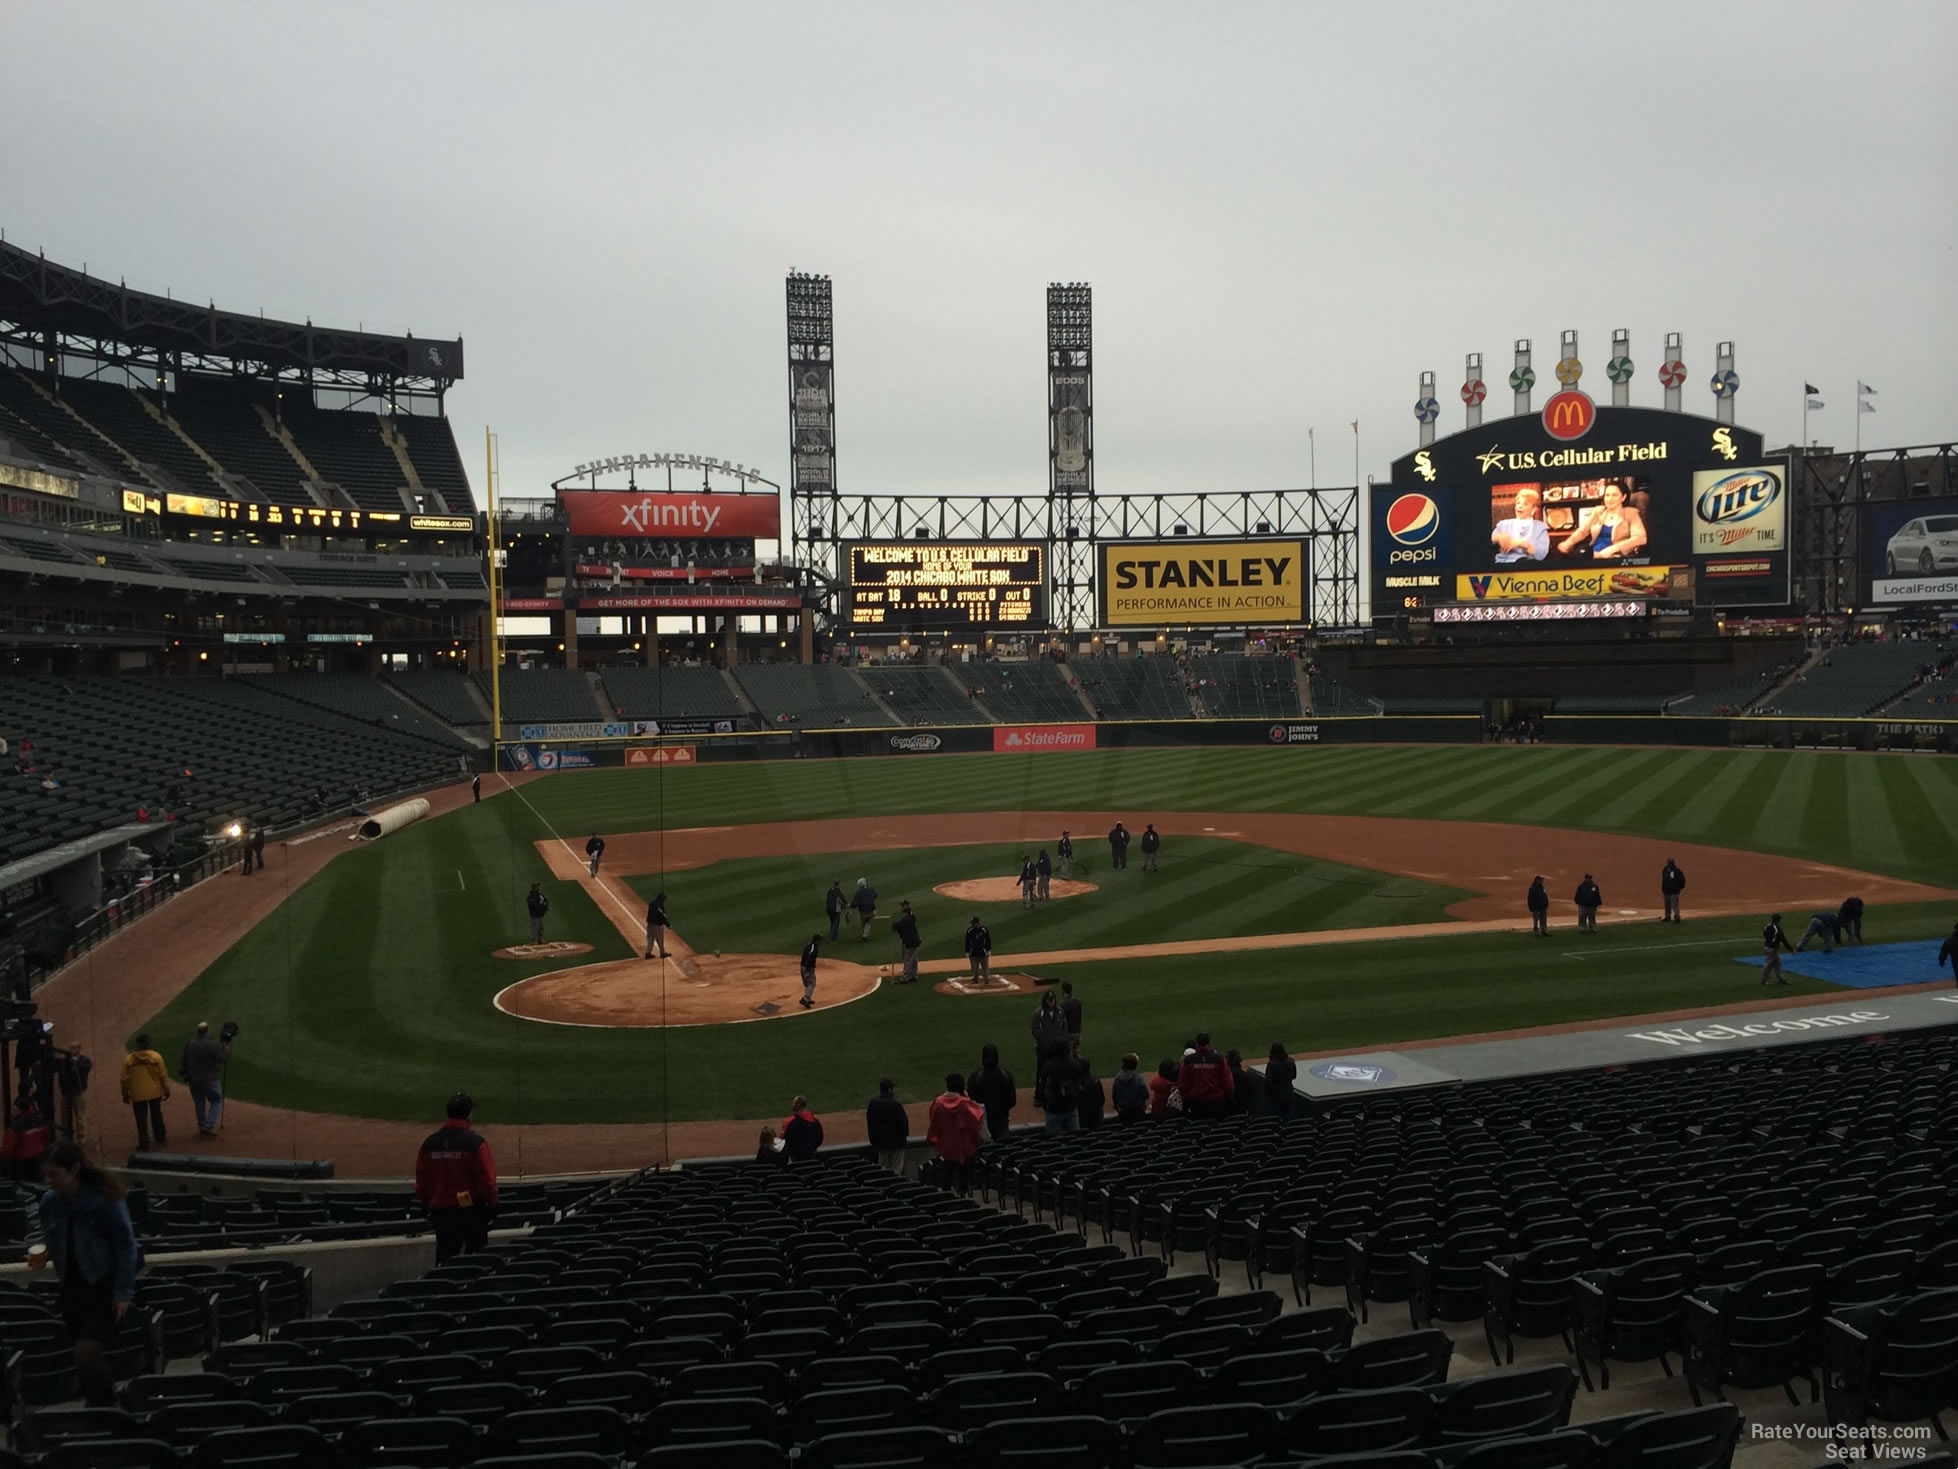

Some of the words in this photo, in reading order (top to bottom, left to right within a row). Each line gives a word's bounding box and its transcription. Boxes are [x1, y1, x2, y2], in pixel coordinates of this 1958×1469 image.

[1508, 453, 1536, 469] U.S.
[1540, 446, 1614, 467] Cellular
[1618, 442, 1667, 462] Field
[574, 453, 760, 484] FUNDAMENTALS
[1708, 478, 1769, 524] Lite
[414, 519, 469, 528] whitesox.com
[621, 499, 720, 532] xfinity
[1700, 533, 1714, 544] IT'S
[1716, 527, 1756, 546] Miller
[1757, 529, 1775, 540] TIME
[864, 549, 914, 562] WELCOME
[916, 549, 929, 562] TO
[950, 549, 1000, 562] CELLULAR
[1001, 549, 1028, 562] FIELD
[1390, 546, 1436, 564] pepsi
[922, 562, 942, 570] HOME
[943, 562, 952, 570] OF
[954, 562, 972, 570] YOUR
[1116, 558, 1291, 589] STANLEY
[887, 570, 912, 583] 2014
[914, 570, 956, 583] CHICAGO
[957, 570, 988, 583] WHITE
[990, 570, 1010, 583] SOX
[1386, 577, 1418, 587] MUSCLE
[1419, 576, 1440, 586] MILK
[1497, 577, 1558, 593] Vienna
[1563, 574, 1605, 594] Beef
[857, 592, 867, 602] AT
[868, 592, 883, 602] BAT
[888, 589, 900, 602] 18
[918, 592, 937, 602] BALL
[940, 589, 948, 601] 0
[957, 592, 986, 601] STRIKE
[989, 588, 996, 600] 0
[1006, 591, 1021, 600] OUT
[1023, 588, 1030, 600] 0
[1117, 597, 1213, 610] PERFORMANCE
[1217, 596, 1230, 608] IN
[1235, 596, 1285, 607] ACTION
[1288, 725, 1318, 734] JIMMY
[1288, 734, 1319, 742] JOHN'S
[1625, 1008, 1890, 1046] Welcome
